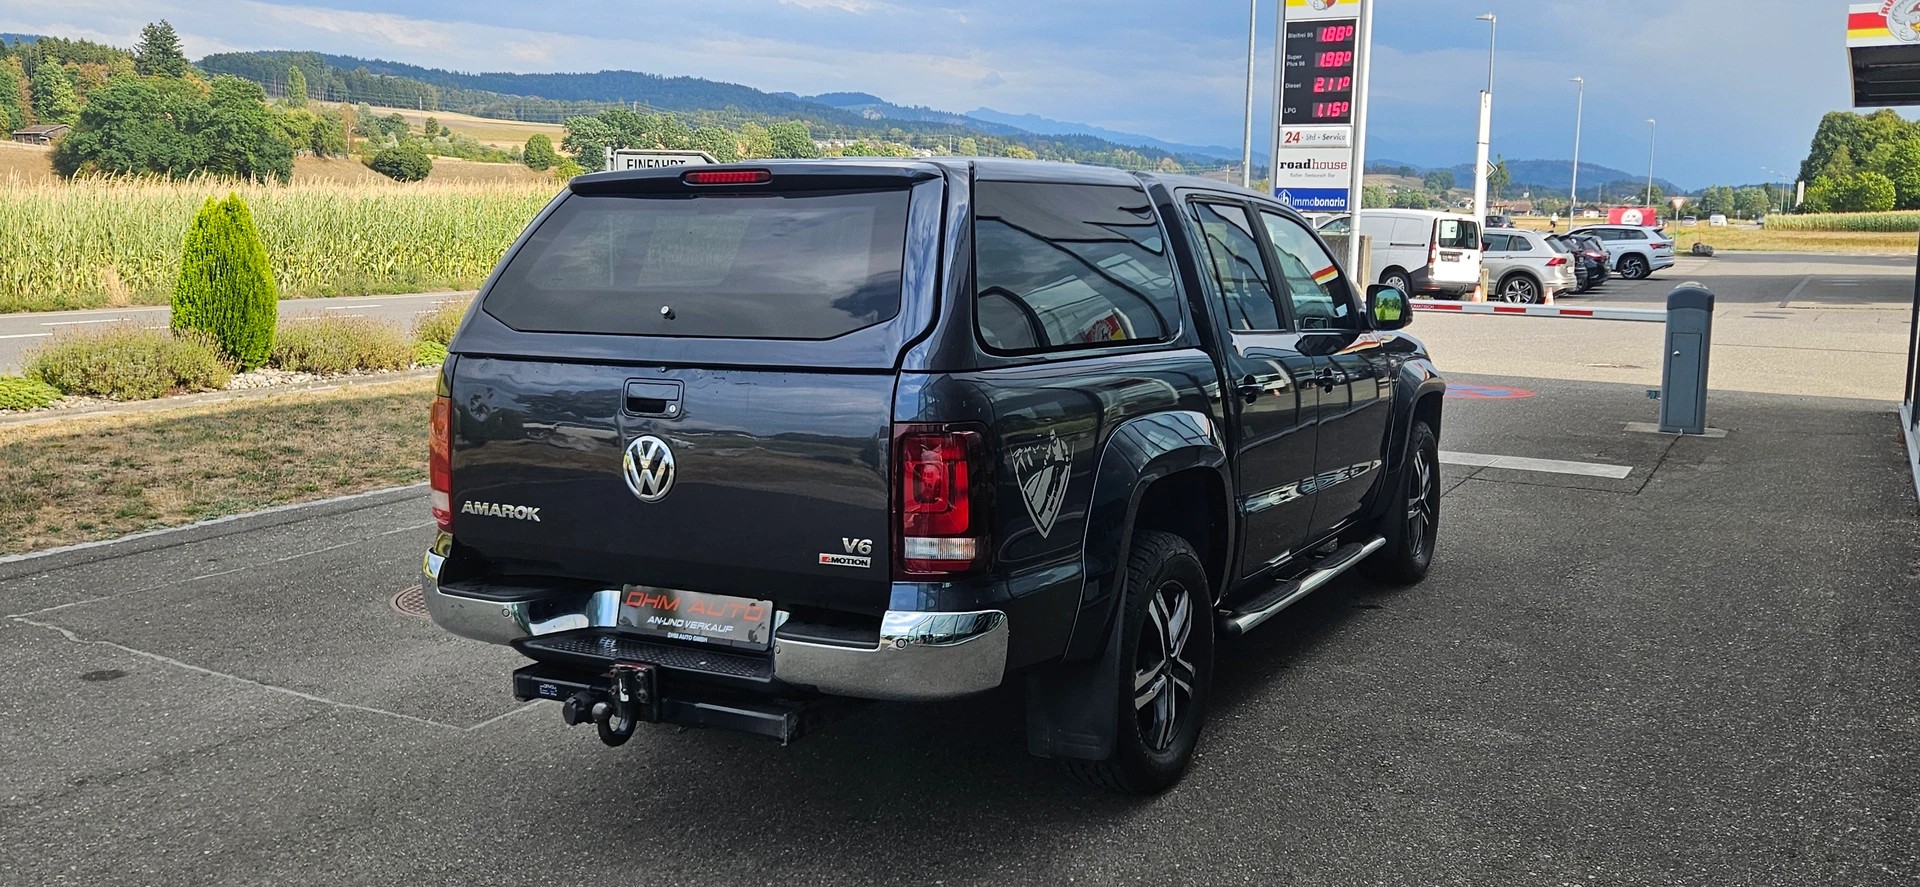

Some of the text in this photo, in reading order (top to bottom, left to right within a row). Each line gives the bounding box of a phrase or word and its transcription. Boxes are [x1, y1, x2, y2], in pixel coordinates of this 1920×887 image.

[1284, 131, 1301, 144] 24
[1280, 158, 1347, 170] roadhouse
[1292, 197, 1345, 206] immobonaria
[461, 500, 541, 522] AMAROK
[842, 537, 873, 555] V6
[688, 601, 765, 622] AUTO
[684, 620, 734, 633] VERKAUF
